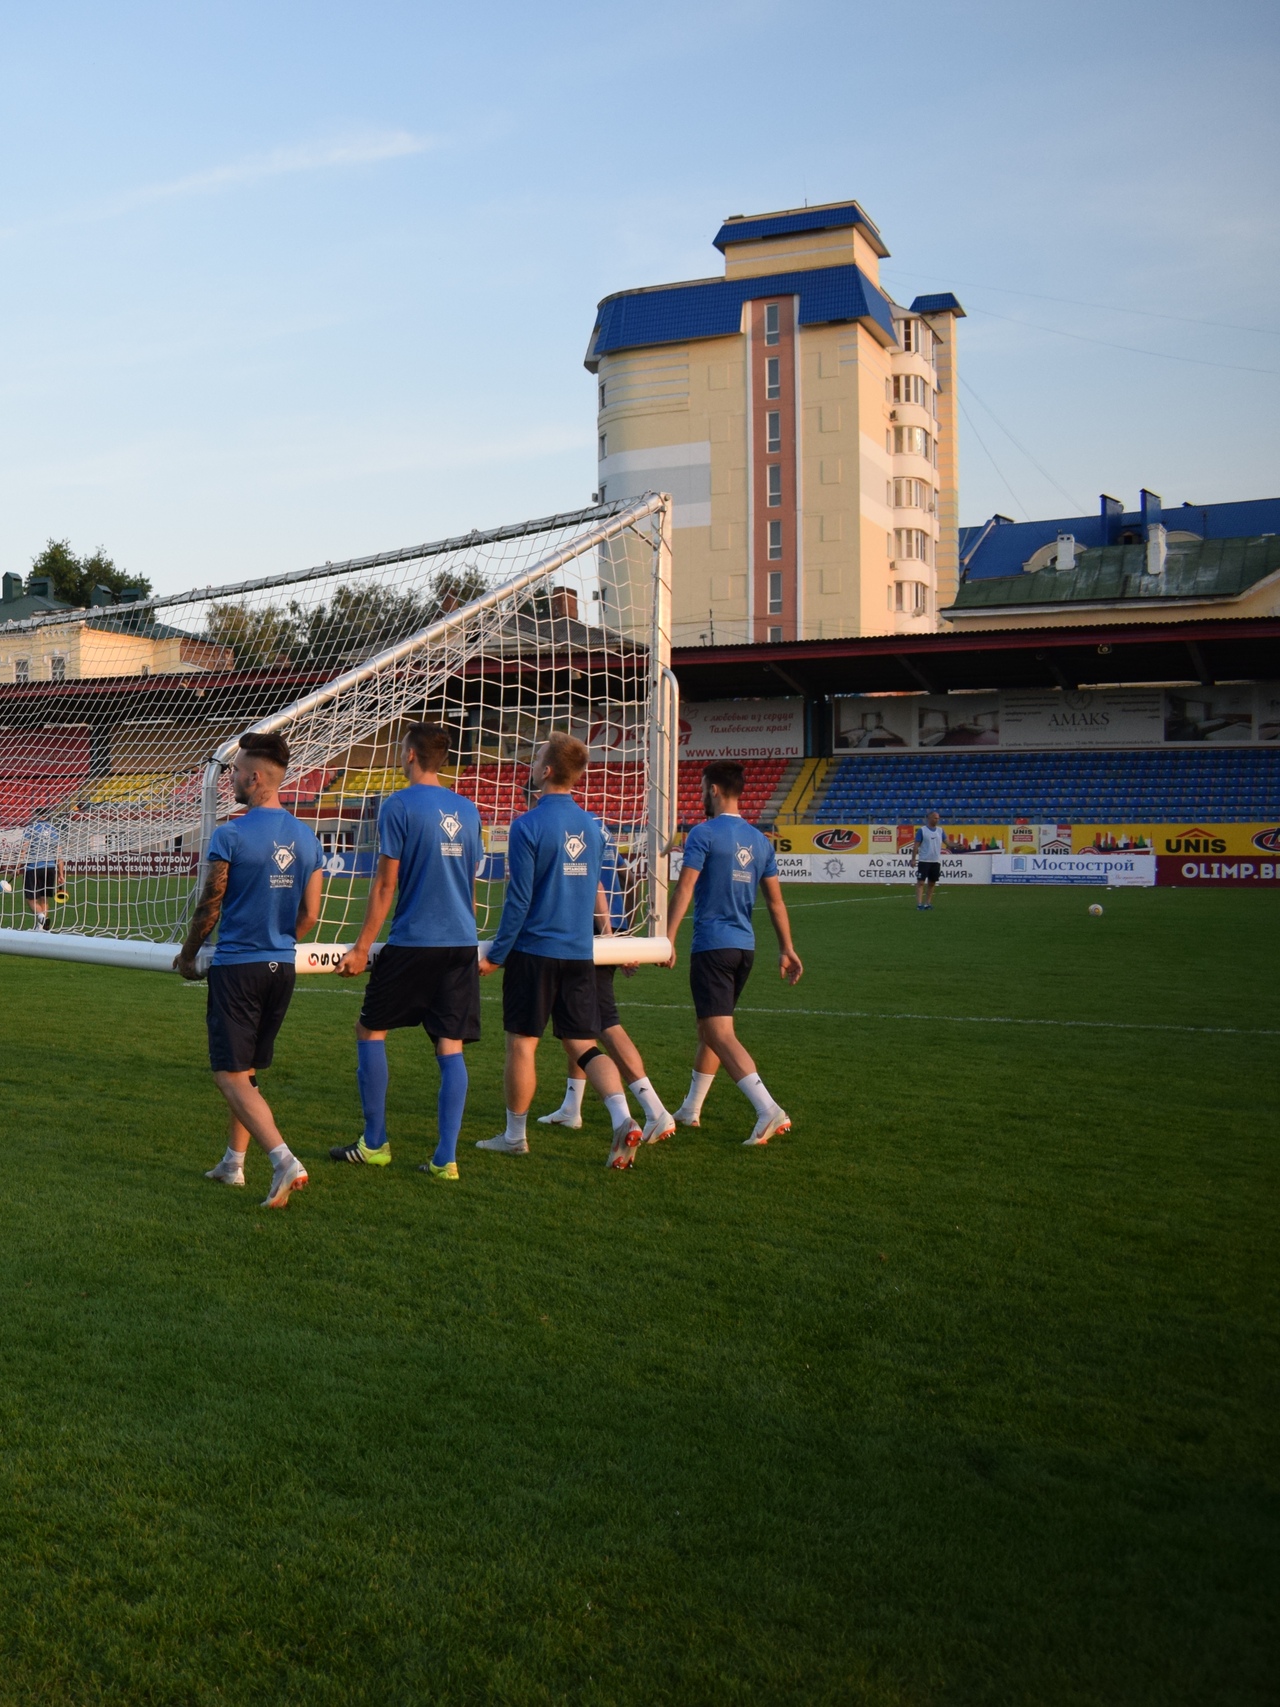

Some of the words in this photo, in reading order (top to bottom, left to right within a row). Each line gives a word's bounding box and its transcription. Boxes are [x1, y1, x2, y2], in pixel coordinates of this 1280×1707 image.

[710, 712, 748, 722] любовью
[751, 713, 762, 723] из
[763, 712, 794, 723] сердца
[1048, 712, 1110, 727] AMAKS
[709, 724, 764, 734] Тамбовского
[766, 722, 792, 734] края!
[685, 746, 799, 759] www.vkusmaya.ru
[1165, 839, 1227, 854] UNIS
[154, 856, 190, 864] ФУТБОЛУ
[869, 859, 884, 867] АО
[1032, 858, 1134, 873] Мостострой
[125, 865, 154, 873] СЕЗОНА
[858, 869, 906, 878] СЕТЕВАЯ
